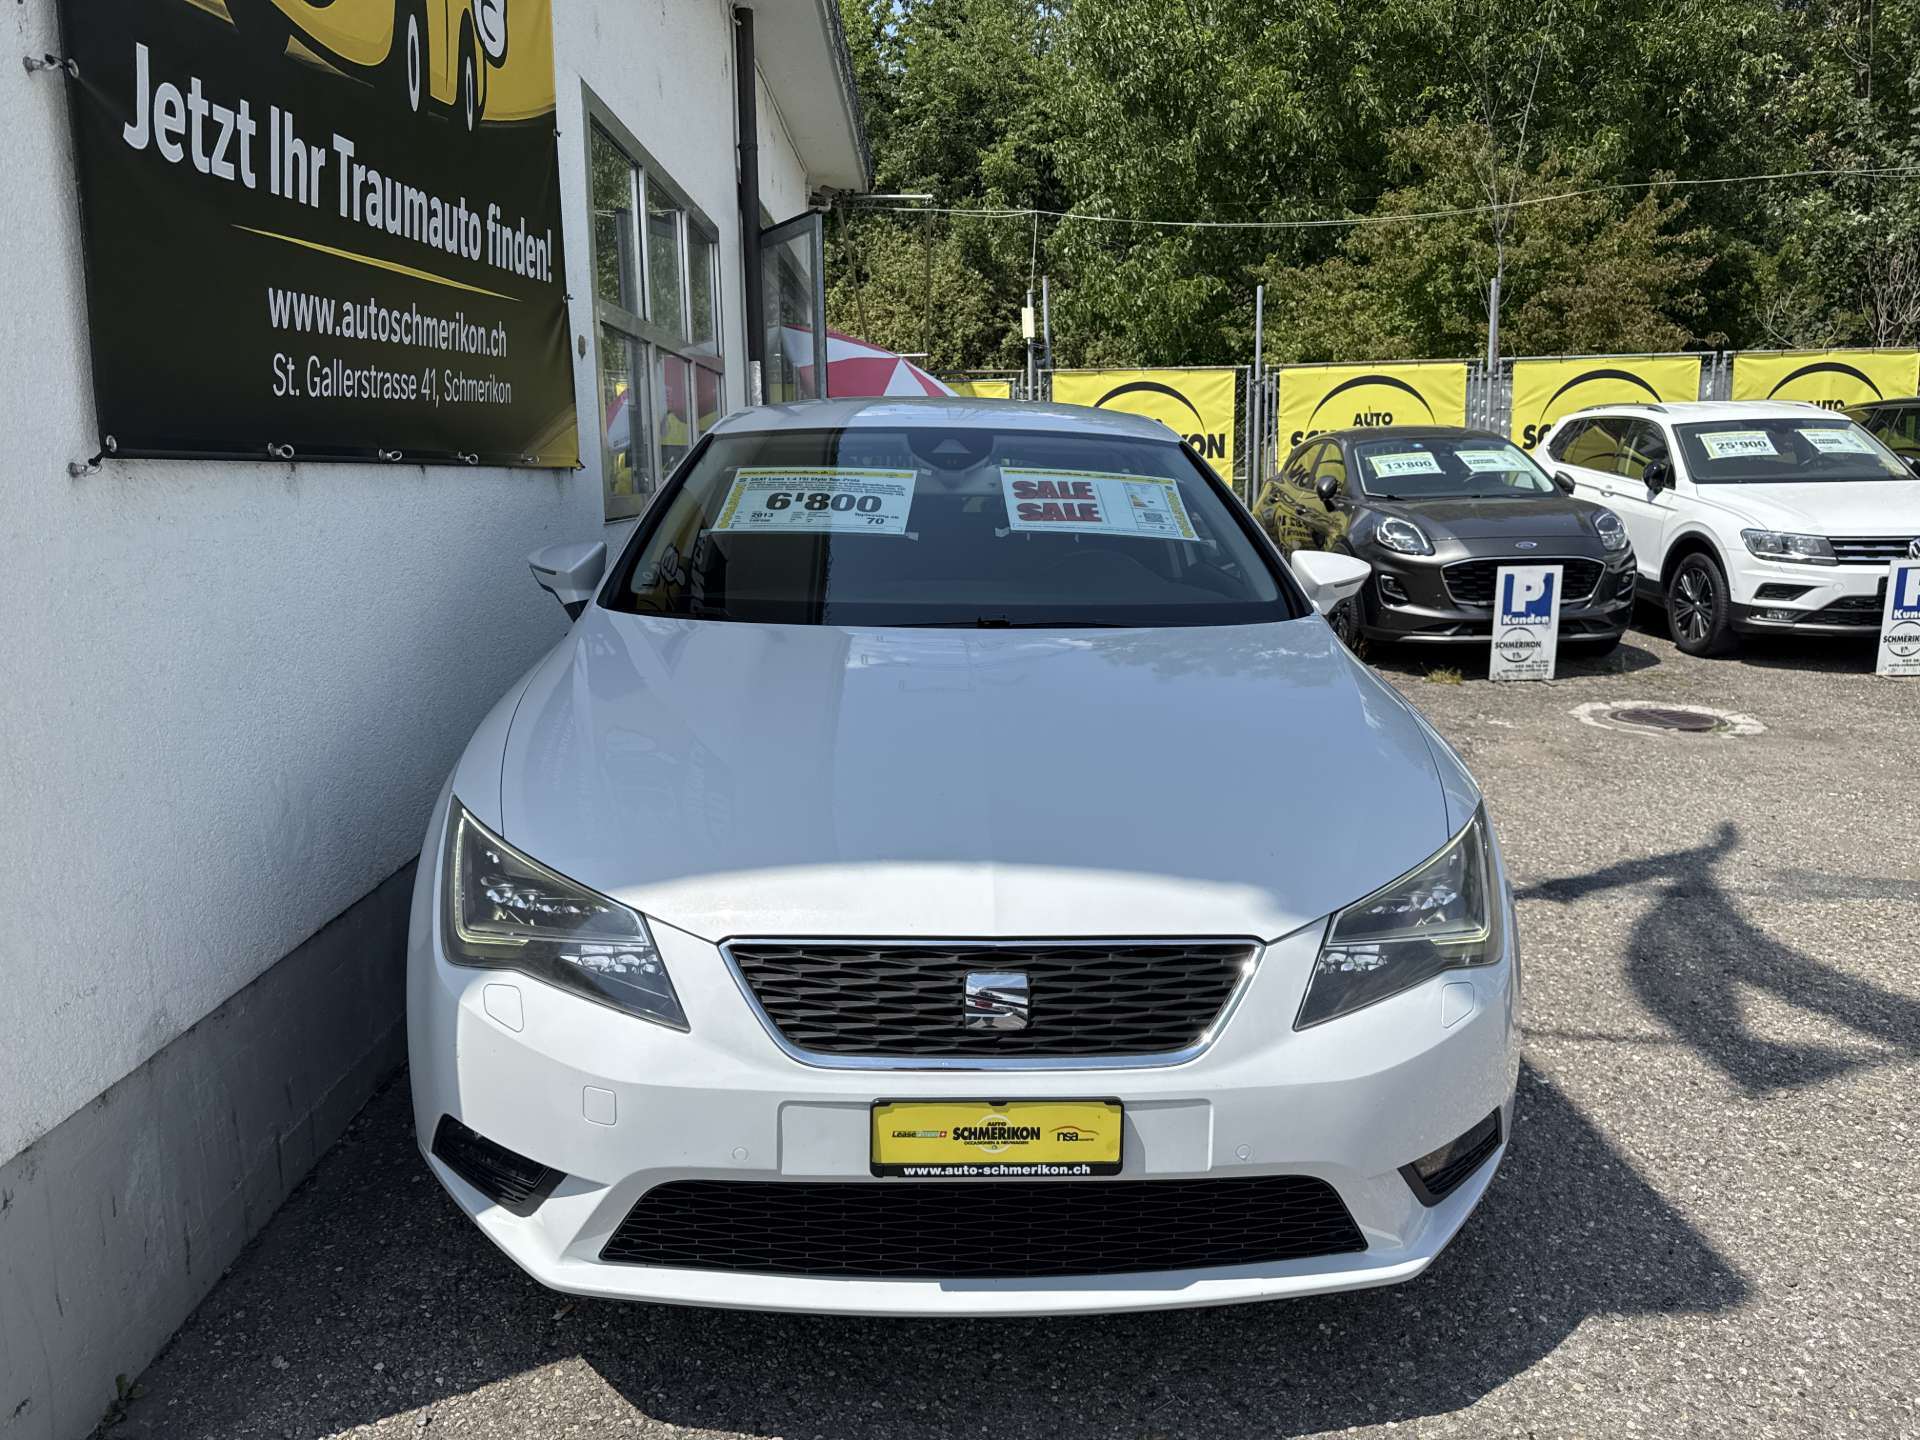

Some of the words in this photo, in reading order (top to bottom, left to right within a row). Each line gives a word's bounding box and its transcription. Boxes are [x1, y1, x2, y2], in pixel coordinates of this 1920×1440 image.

[122, 42, 257, 190] Jetzt
[269, 105, 326, 208] Ihr
[333, 133, 482, 263] Traumauto
[487, 204, 553, 284] finden!
[268, 287, 508, 358] www.autoschmerikon.ch
[272, 353, 301, 398] St.
[306, 355, 418, 402] Gallerstrasse
[420, 375, 440, 409] 41,
[444, 377, 512, 405] Schmerikon
[1353, 412, 1394, 427] AUTO
[1716, 440, 1767, 450] 25'900
[1384, 460, 1433, 470] 13'800
[1012, 480, 1096, 500] SALE
[765, 492, 883, 513] 6'800
[1016, 502, 1103, 523] SALE
[867, 517, 885, 525] 70
[1511, 573, 1546, 613] P
[1502, 613, 1550, 625] Kunden
[1893, 609, 1920, 620] Kun
[1494, 640, 1542, 650] SCHMERIKON
[952, 1126, 1041, 1141] SCHMERIKON
[1057, 1131, 1079, 1142] nsa
[903, 1164, 1091, 1176] www.auto-schmerikon.ch
